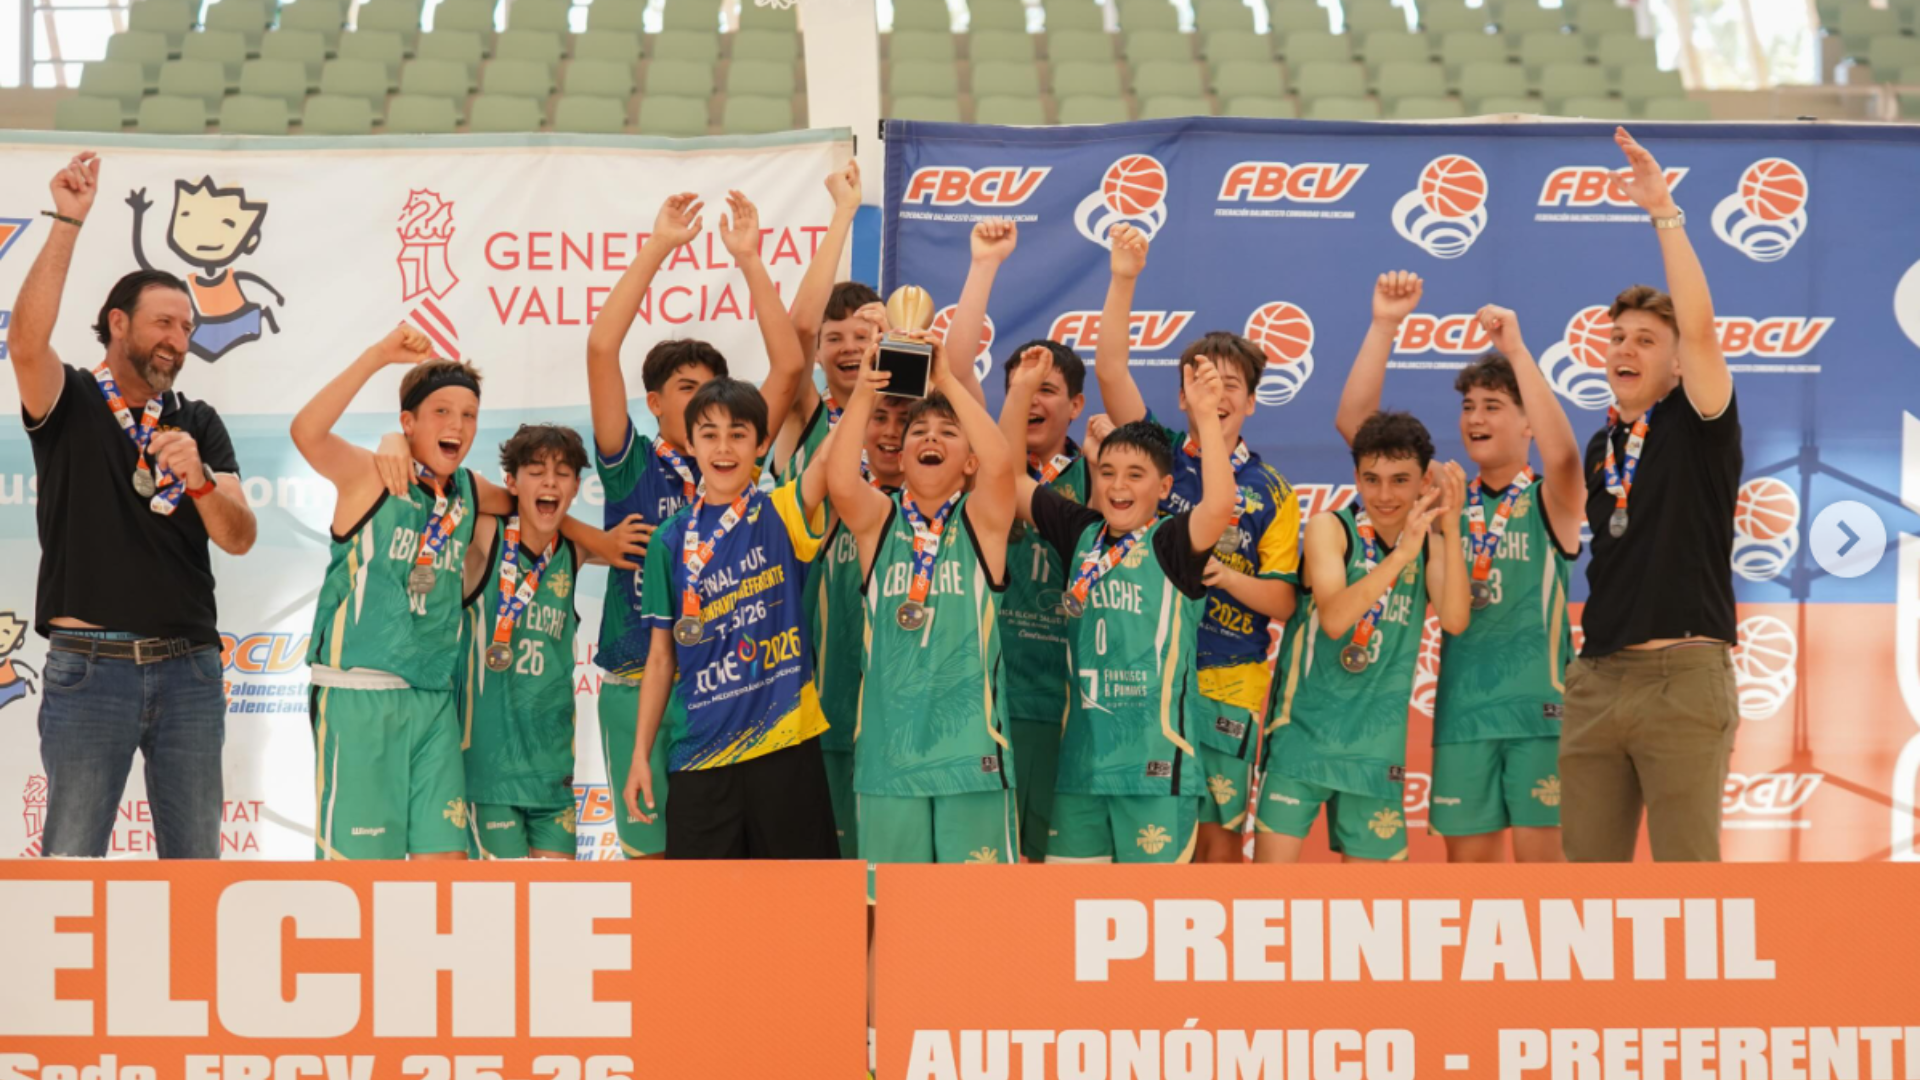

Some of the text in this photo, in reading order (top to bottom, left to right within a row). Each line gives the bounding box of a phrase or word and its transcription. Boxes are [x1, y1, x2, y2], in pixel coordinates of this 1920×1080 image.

[902, 166, 1053, 207] FBCV
[1217, 161, 1370, 203] FBCV
[1537, 166, 1691, 207] FBC
[1393, 313, 1495, 354] BCV
[1713, 316, 1836, 357] BCV
[837, 532, 858, 563] CB
[728, 600, 768, 633] 5/26
[1091, 579, 1143, 614] ELCHE
[759, 626, 802, 671] 2026
[1095, 617, 1108, 656] 0
[0, 880, 632, 1038] ELCHE
[1074, 897, 1776, 982] PREINFANTIL
[905, 1017, 1416, 1080] AUTONÓMICO
